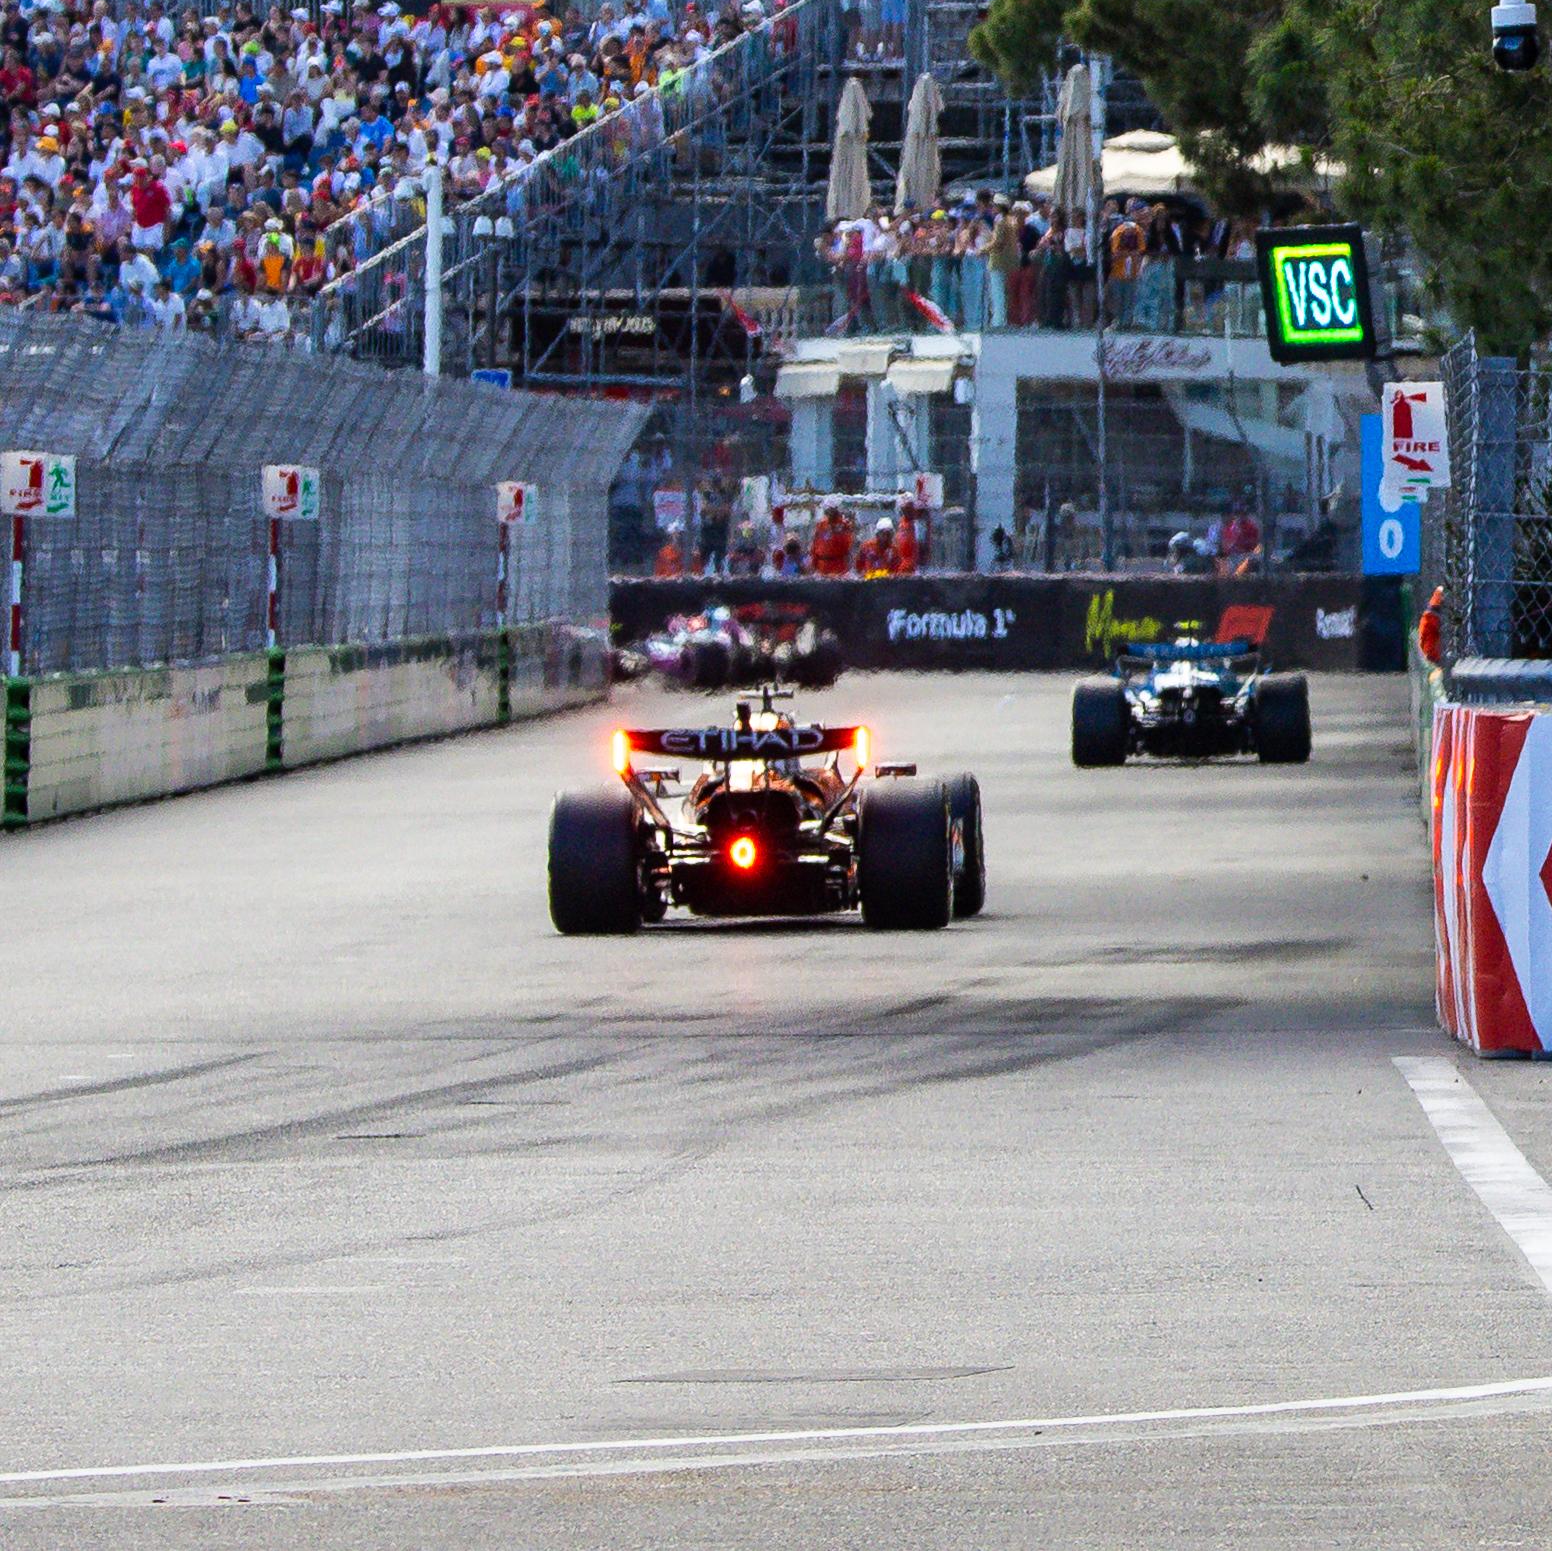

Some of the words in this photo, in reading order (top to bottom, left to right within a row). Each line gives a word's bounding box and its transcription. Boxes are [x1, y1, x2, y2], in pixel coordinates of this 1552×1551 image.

[1284, 258, 1354, 326] VSC
[1392, 441, 1441, 453] FIRE
[887, 607, 987, 642] Formula
[660, 728, 824, 749] ETIHAD
